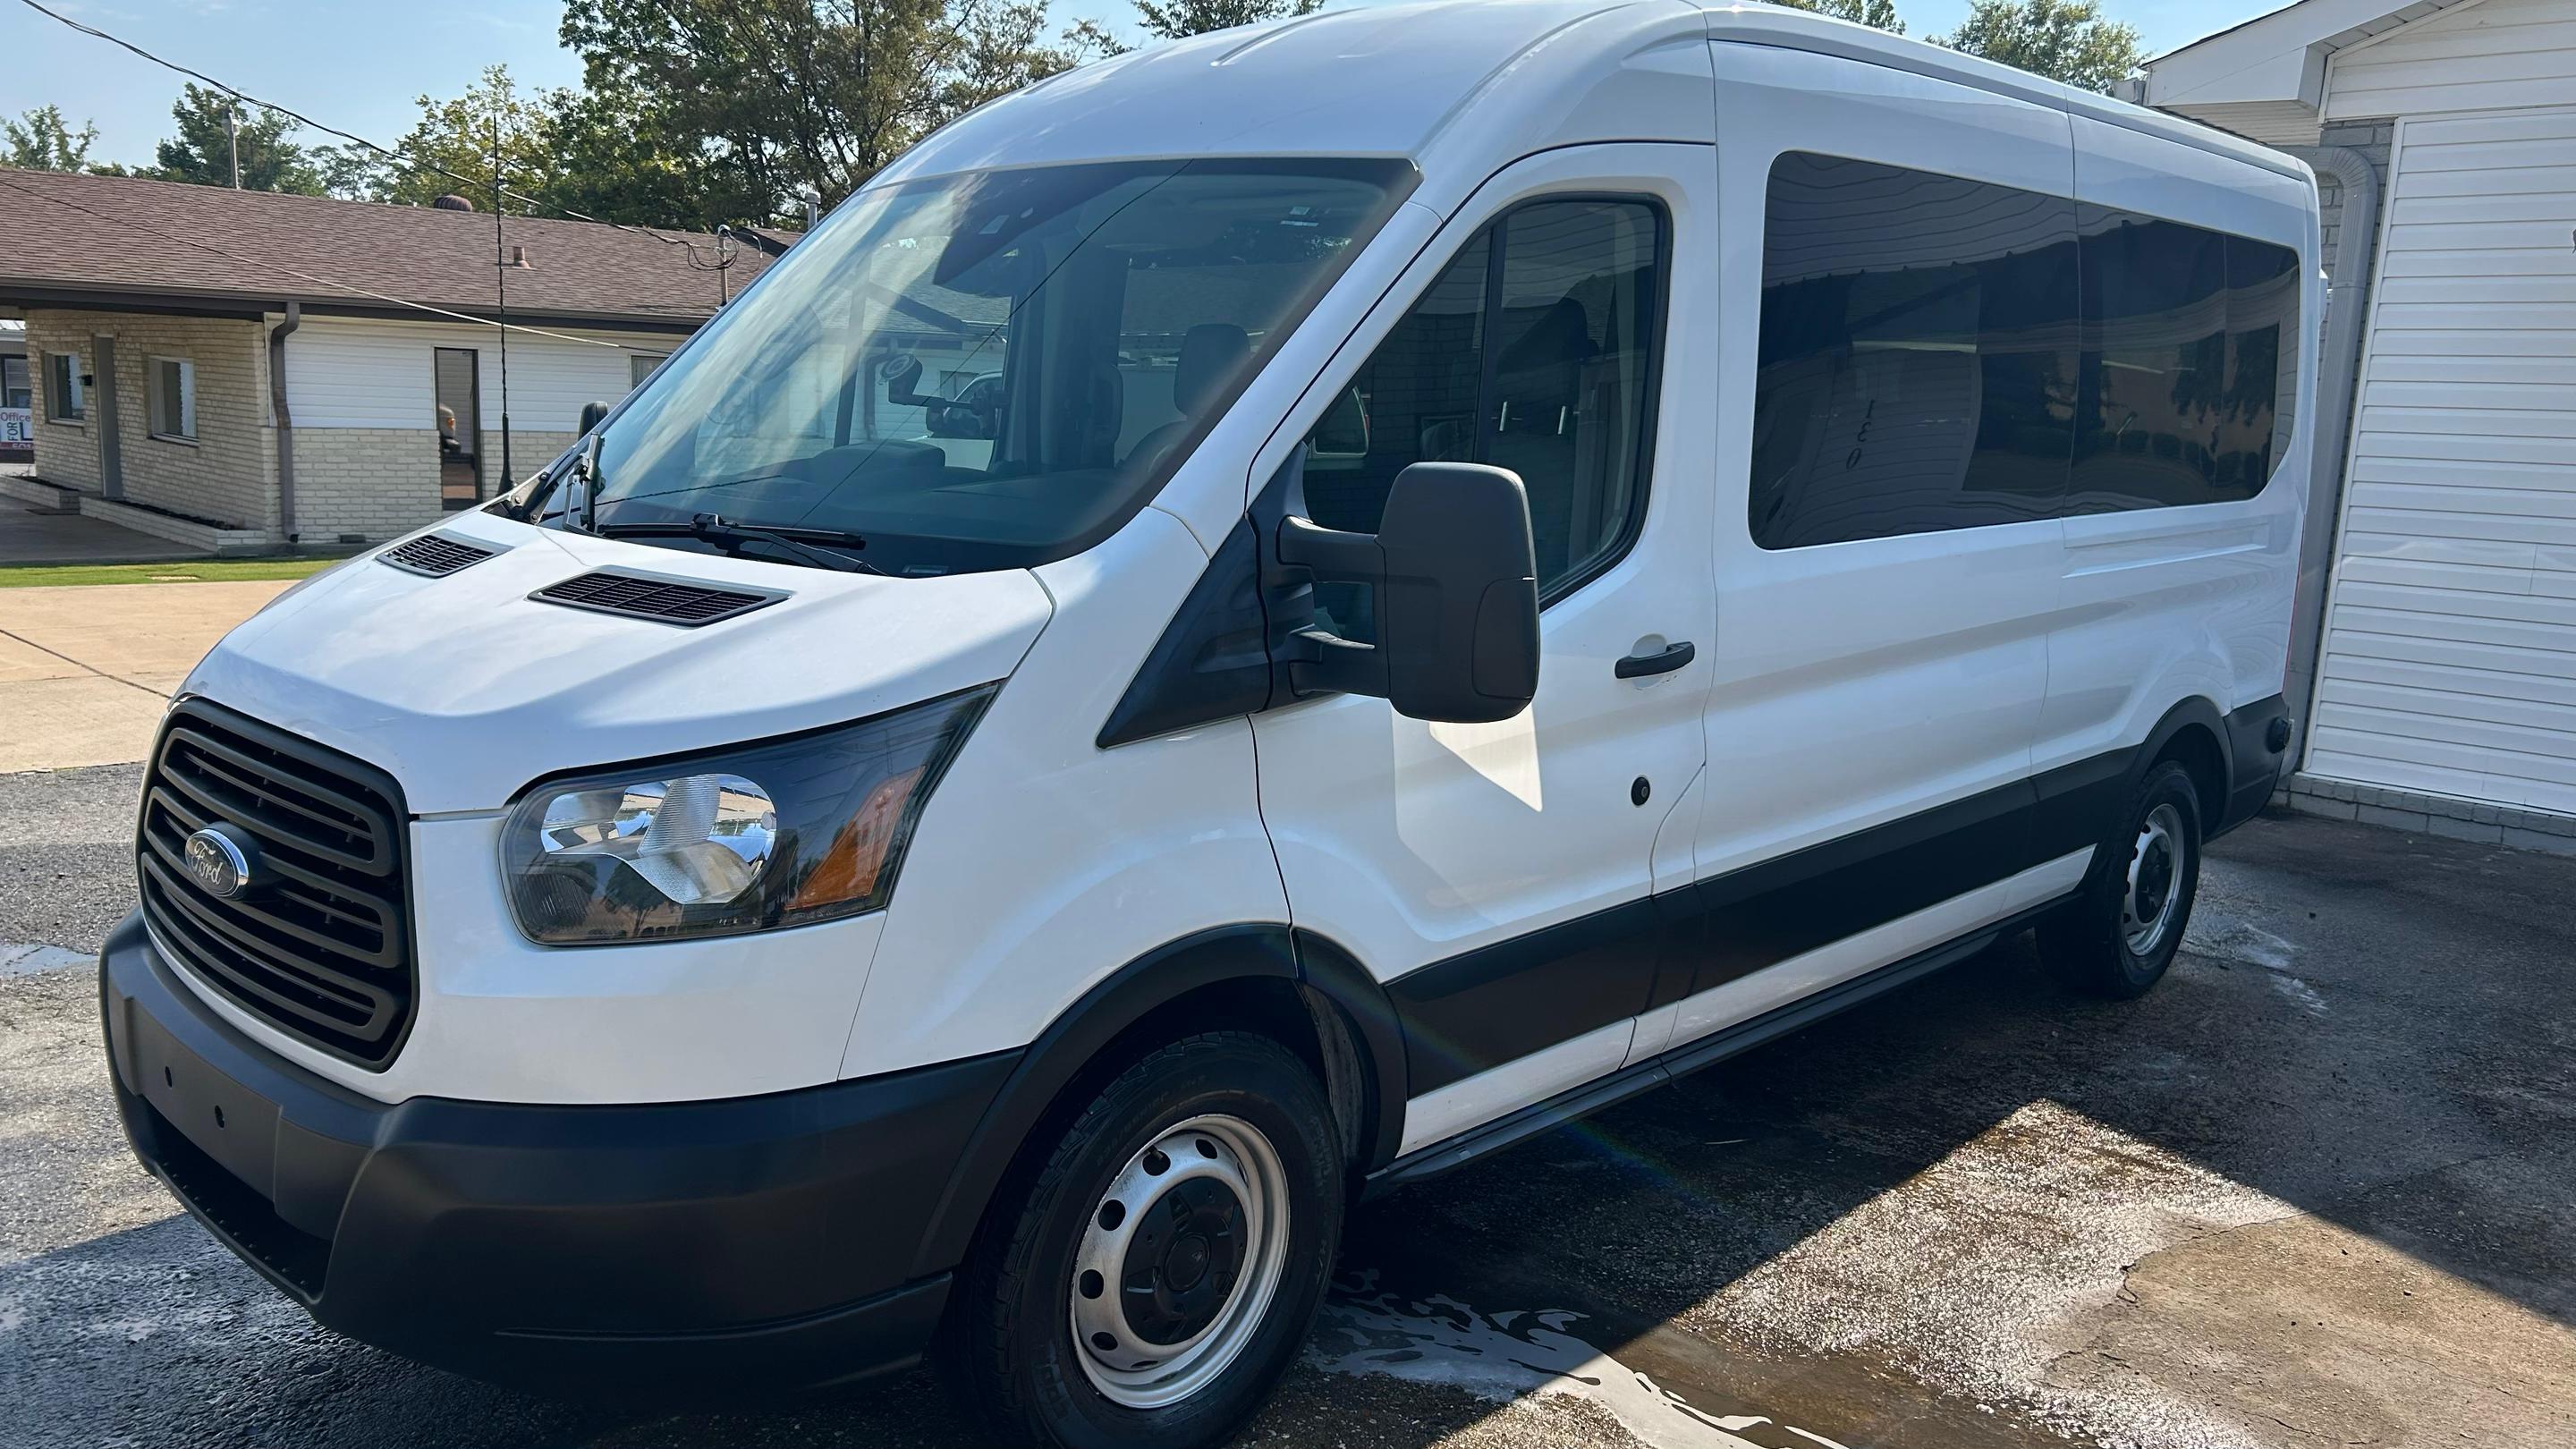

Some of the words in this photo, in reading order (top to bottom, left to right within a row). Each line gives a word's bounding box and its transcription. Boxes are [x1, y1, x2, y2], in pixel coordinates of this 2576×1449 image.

[1, 411, 31, 422] Office
[7, 422, 18, 441] FOR
[191, 841, 223, 885] Ford
